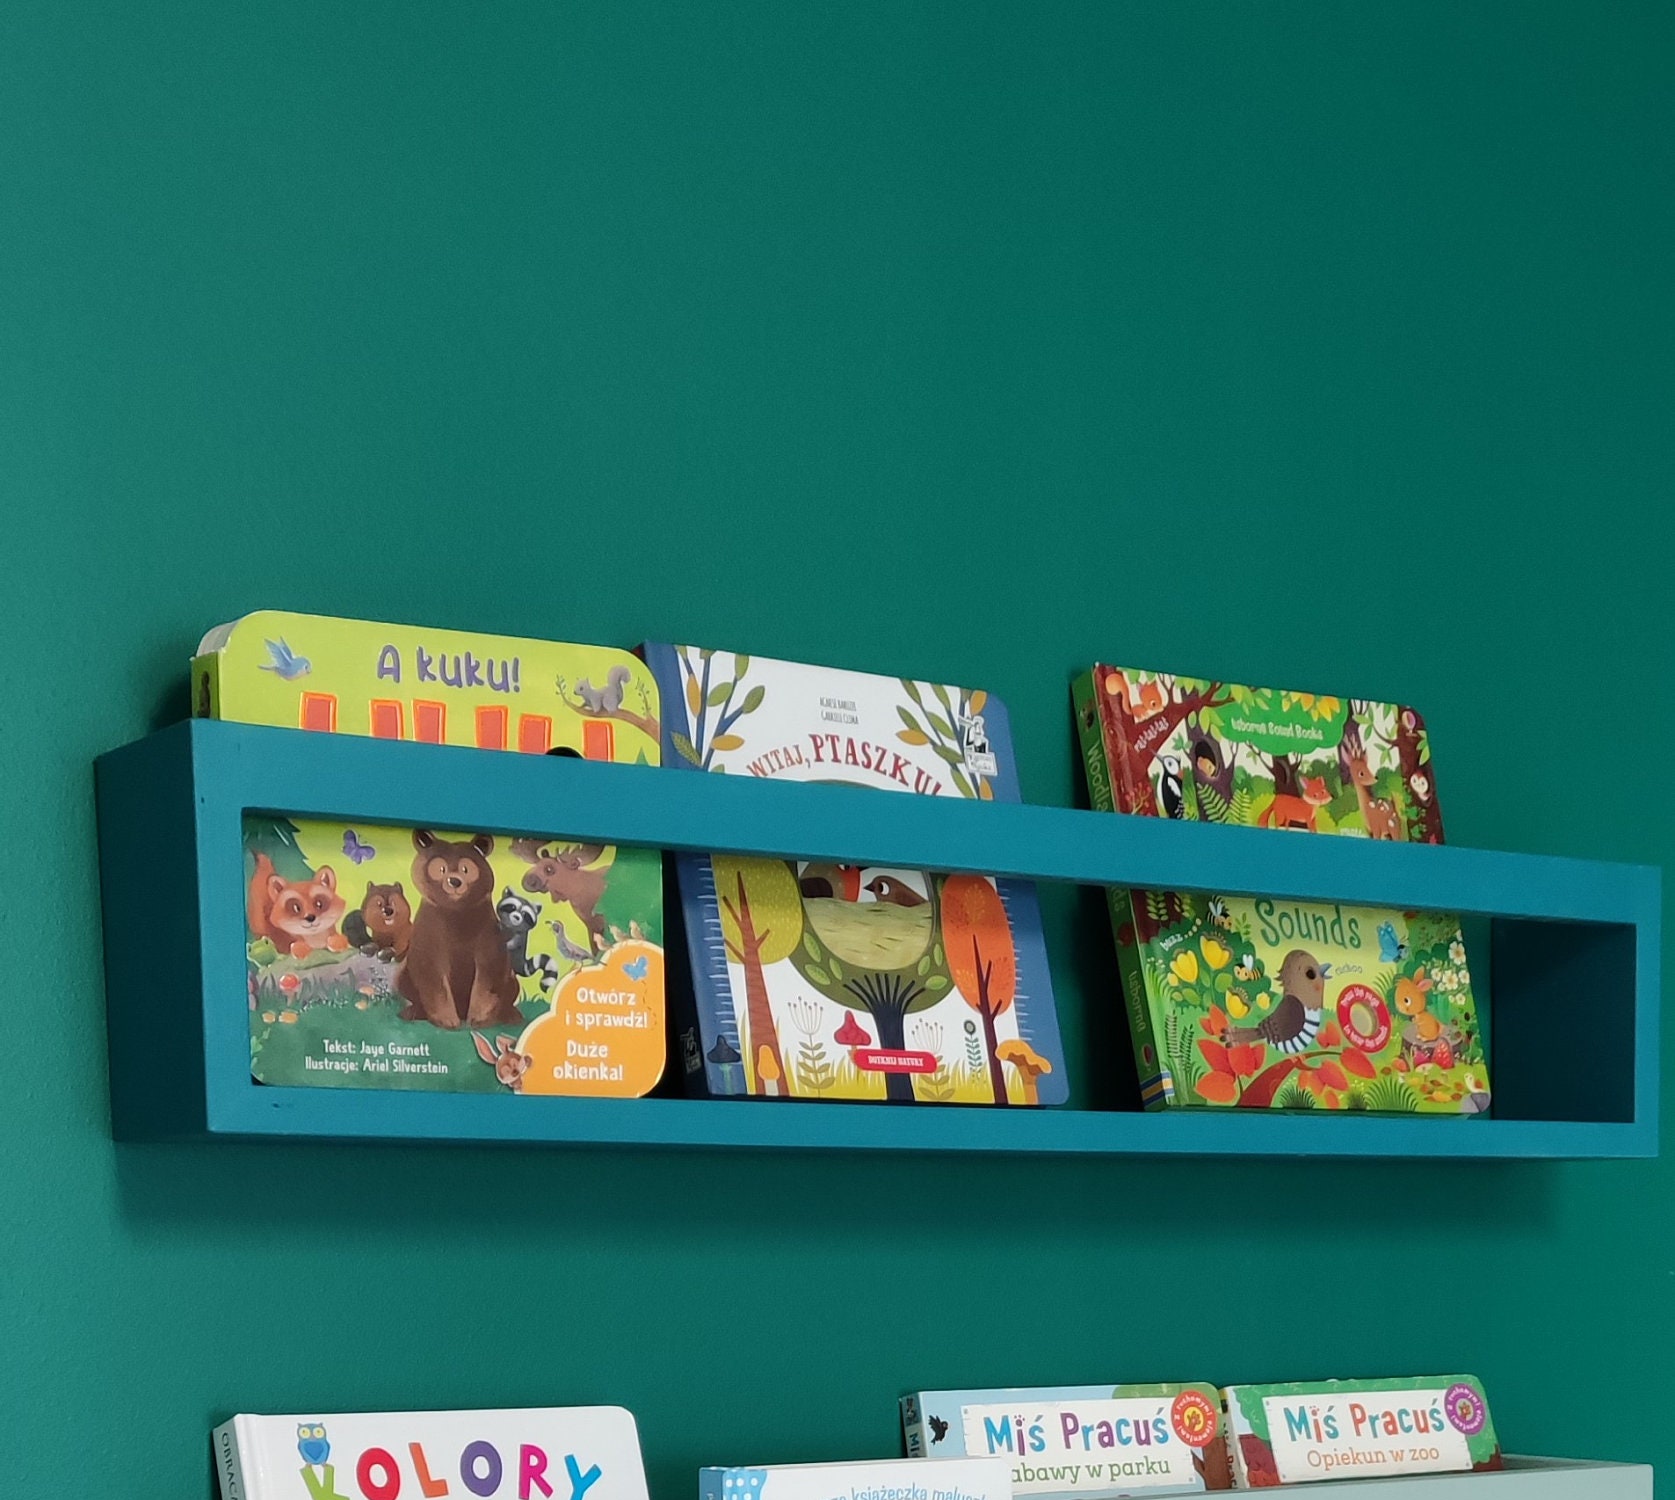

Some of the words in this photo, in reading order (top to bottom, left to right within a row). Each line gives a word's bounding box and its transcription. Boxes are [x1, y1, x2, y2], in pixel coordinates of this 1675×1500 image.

[377, 644, 400, 684] A
[416, 645, 520, 693] kuku!
[1295, 724, 1324, 741] Books
[746, 744, 812, 778] WITAJ,
[1254, 897, 1362, 949] Sounds
[576, 986, 636, 1006] Otwórz
[565, 1009, 571, 1026] i
[322, 1039, 356, 1054] Tekst:
[360, 1041, 384, 1057] Jaye
[388, 1042, 430, 1057] Garnett
[566, 1039, 608, 1058] Duże
[305, 1056, 359, 1074] Ilustracje:
[362, 1058, 389, 1073] Ariel
[392, 1059, 449, 1074] Silverstein
[552, 1060, 624, 1081] okienka!
[983, 1414, 1046, 1456] Miś
[1060, 1407, 1169, 1451] Pracuś
[1283, 1404, 1340, 1443] Miś
[1349, 1398, 1445, 1438] Pracuś
[1011, 1462, 1081, 1485] abawy
[1085, 1463, 1103, 1478] w
[1108, 1455, 1171, 1482] parku
[1307, 1447, 1387, 1471] Opiekun
[1389, 1449, 1405, 1461] w
[1408, 1447, 1440, 1461] zoo
